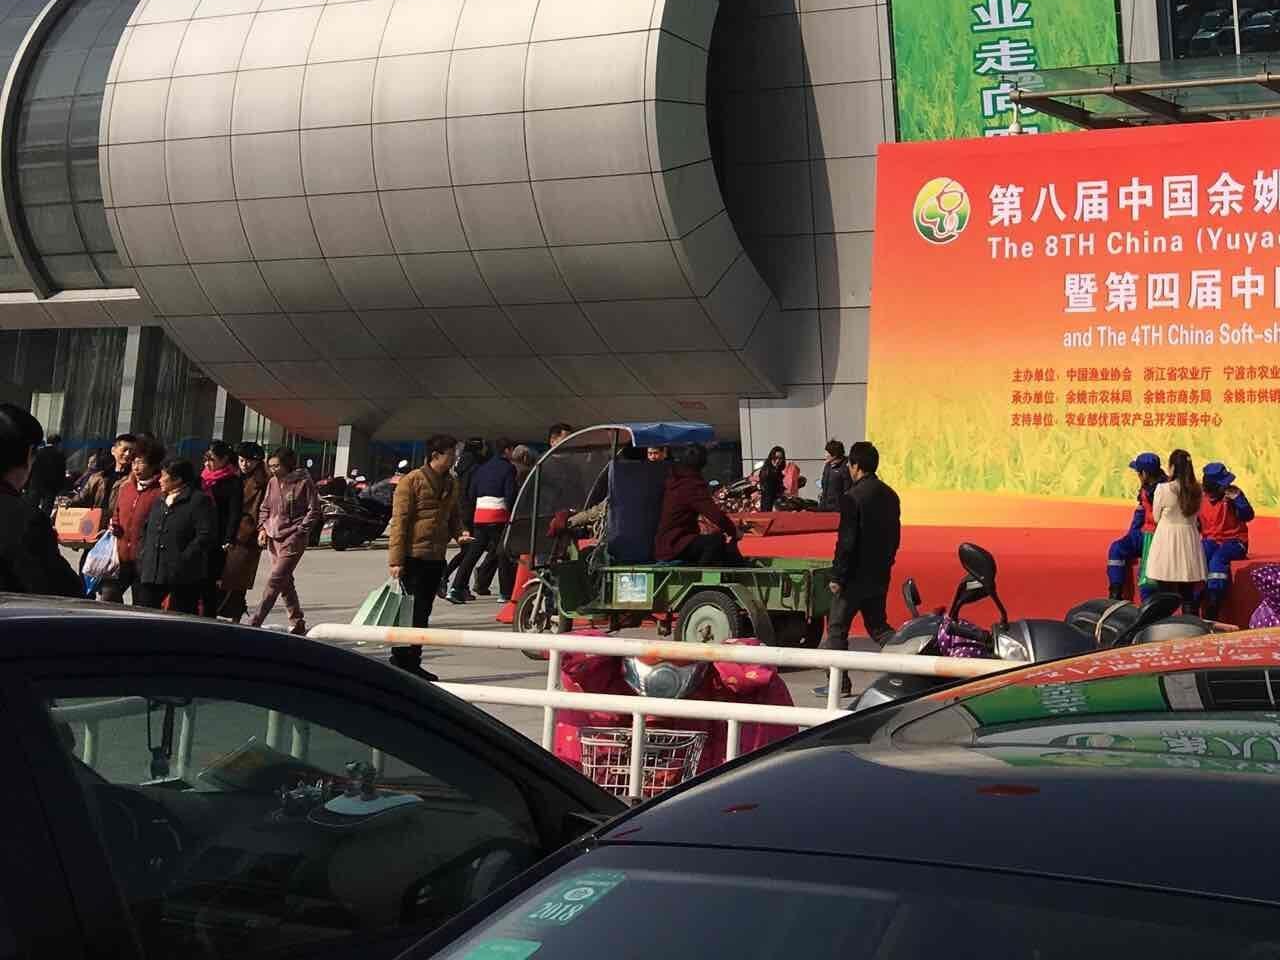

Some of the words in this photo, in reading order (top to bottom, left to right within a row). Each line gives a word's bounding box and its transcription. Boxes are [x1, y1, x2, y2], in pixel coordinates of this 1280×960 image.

[988, 237, 1034, 259] The
[1045, 233, 1095, 257] 8TH
[1107, 231, 1183, 255] China
[1063, 327, 1092, 348] and
[1097, 325, 1126, 346] The
[1131, 324, 1160, 345] 4TH
[1168, 323, 1214, 345] China
[528, 902, 584, 922] 2018
